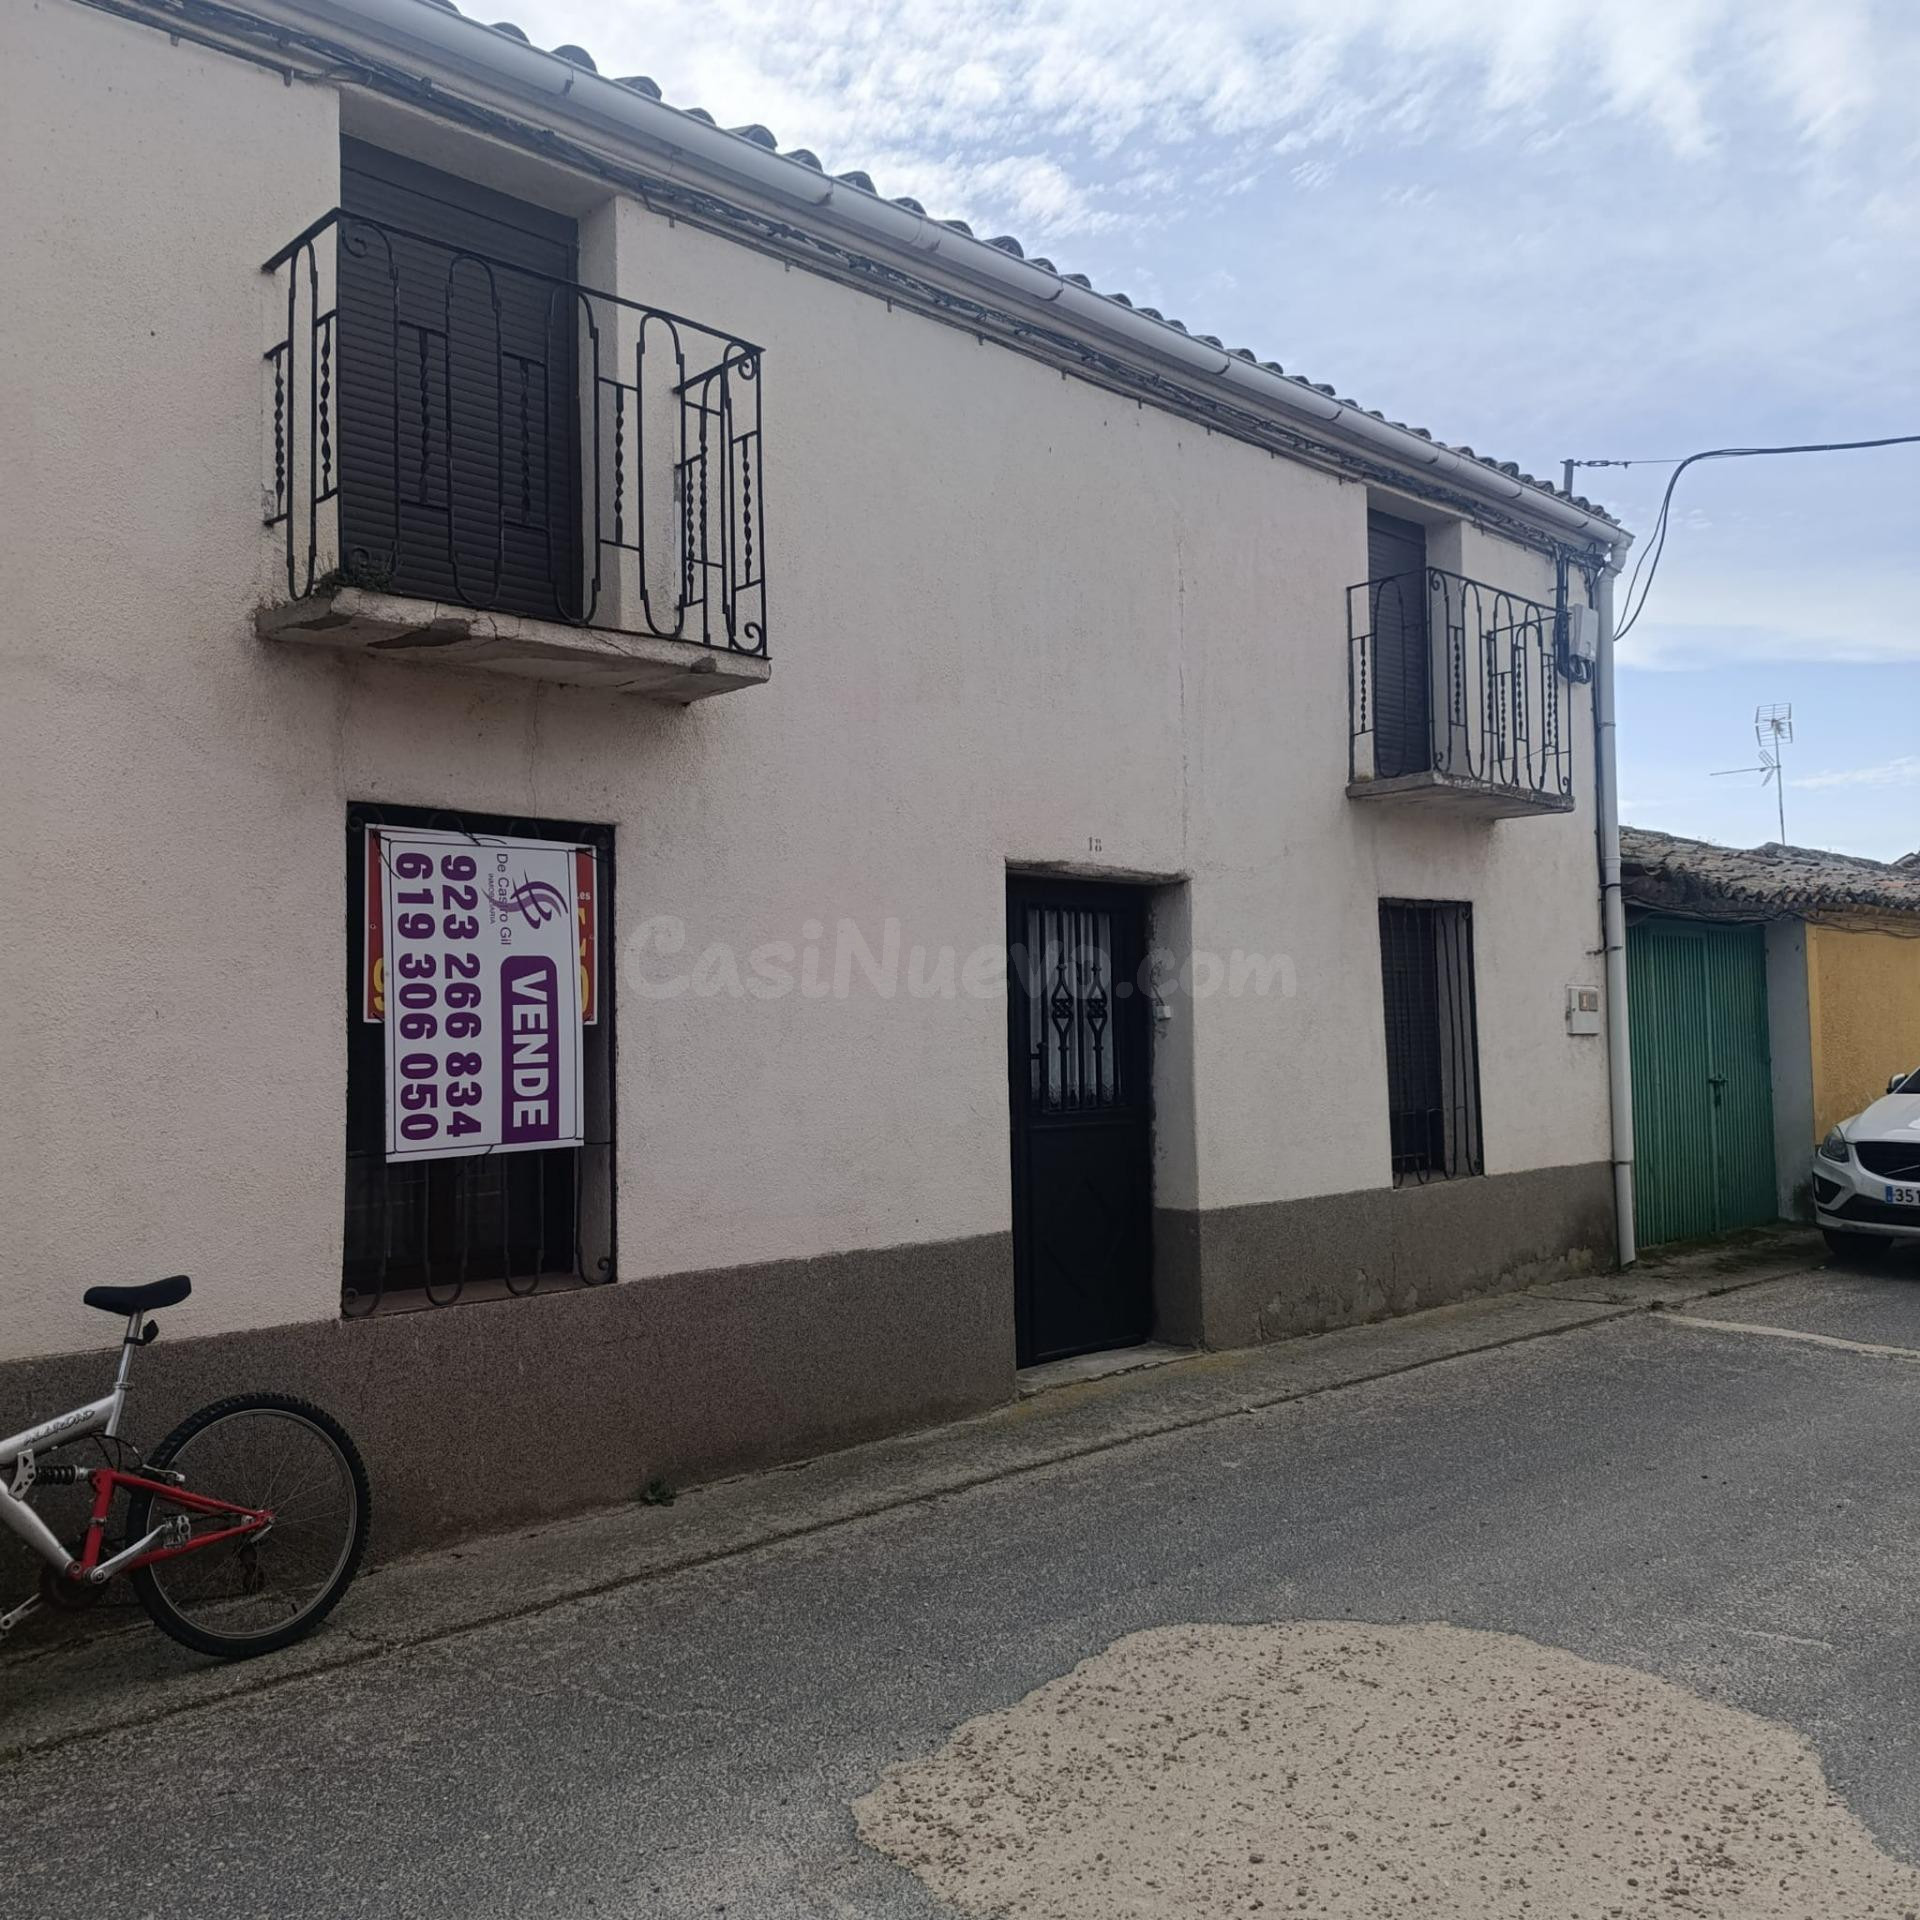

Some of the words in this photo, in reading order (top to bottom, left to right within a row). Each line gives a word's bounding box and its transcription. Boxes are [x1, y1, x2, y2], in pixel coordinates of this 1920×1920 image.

[395, 852, 436, 940] 619
[440, 854, 480, 940] 923
[487, 872, 497, 925] INMOBARIA
[496, 853, 509, 873] De
[500, 926, 512, 946] Gil
[398, 952, 438, 1040] 306
[444, 952, 482, 1038] 266
[511, 969, 550, 1129] VENDE
[400, 1052, 439, 1141] 050
[445, 1051, 483, 1138] 834
